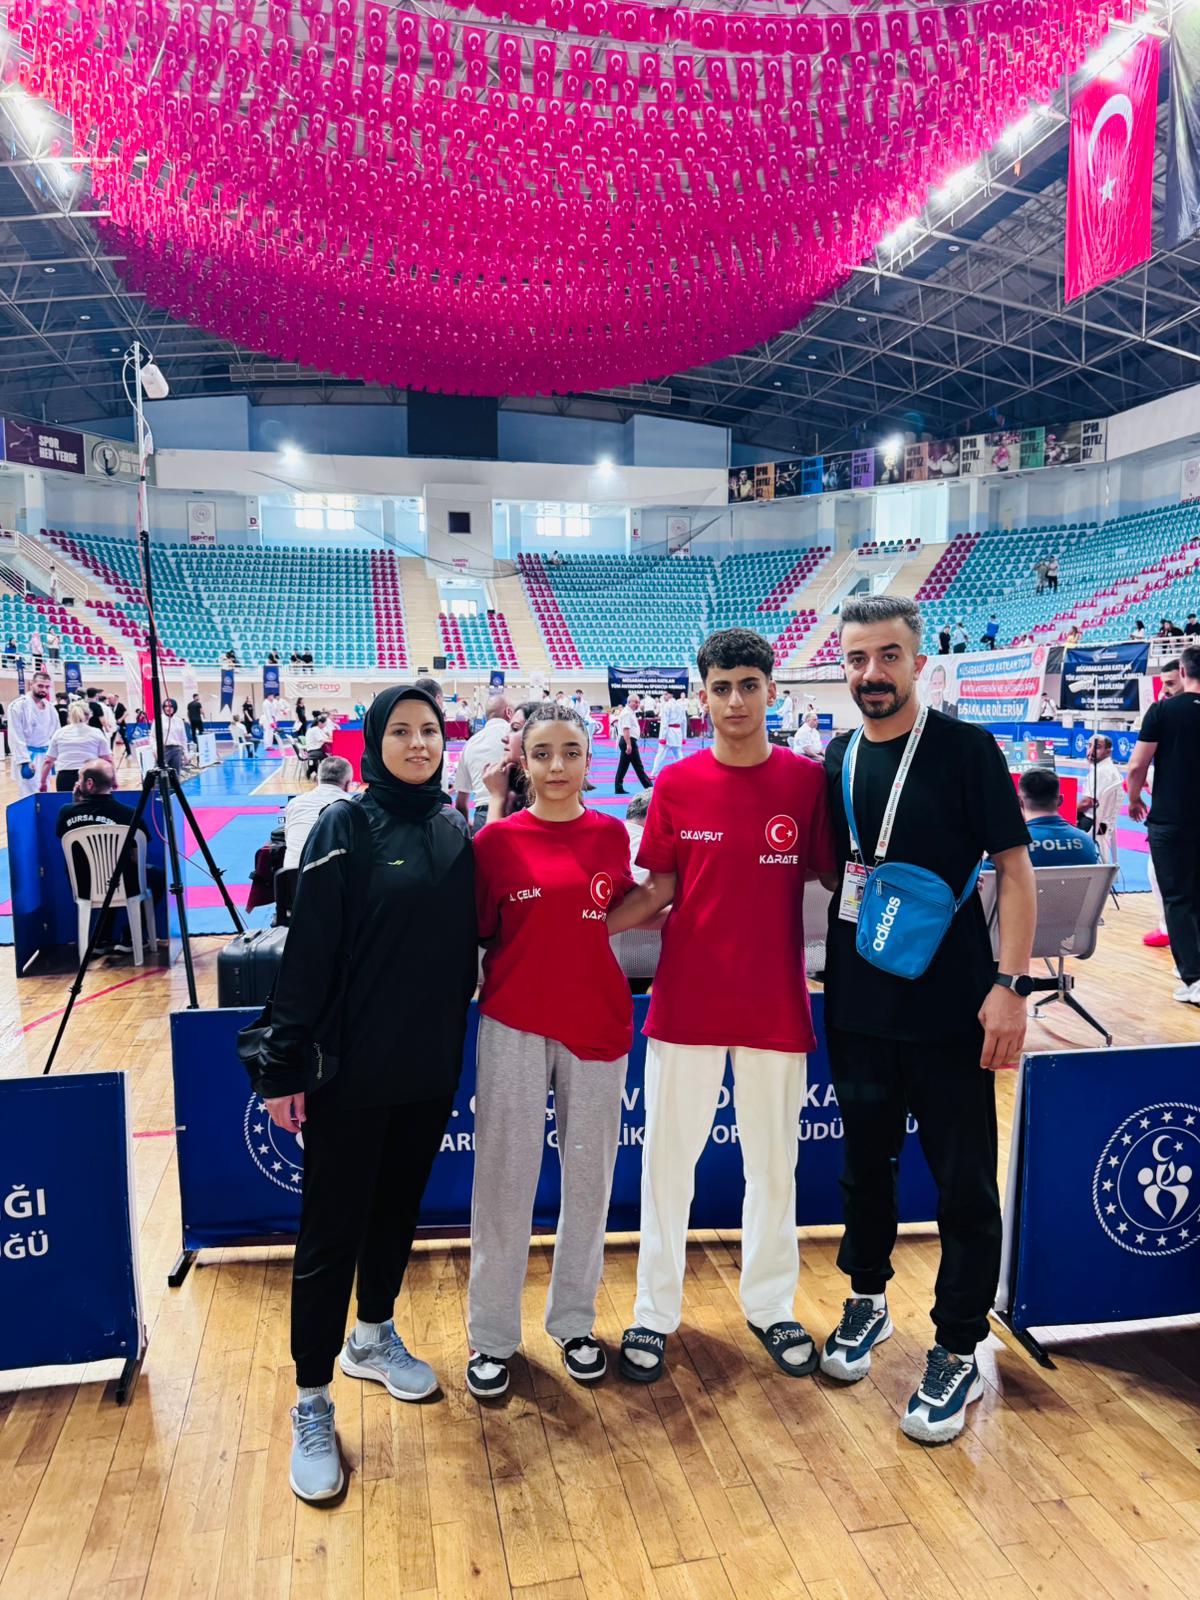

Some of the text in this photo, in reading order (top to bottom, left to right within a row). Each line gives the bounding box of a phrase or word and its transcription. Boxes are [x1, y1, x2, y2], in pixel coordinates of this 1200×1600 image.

[38, 434, 60, 449] SPOR
[66, 815, 94, 827] BURSA
[759, 854, 799, 865] KARATE
[517, 886, 542, 903] ÇELİK
[872, 896, 901, 952] adidas
